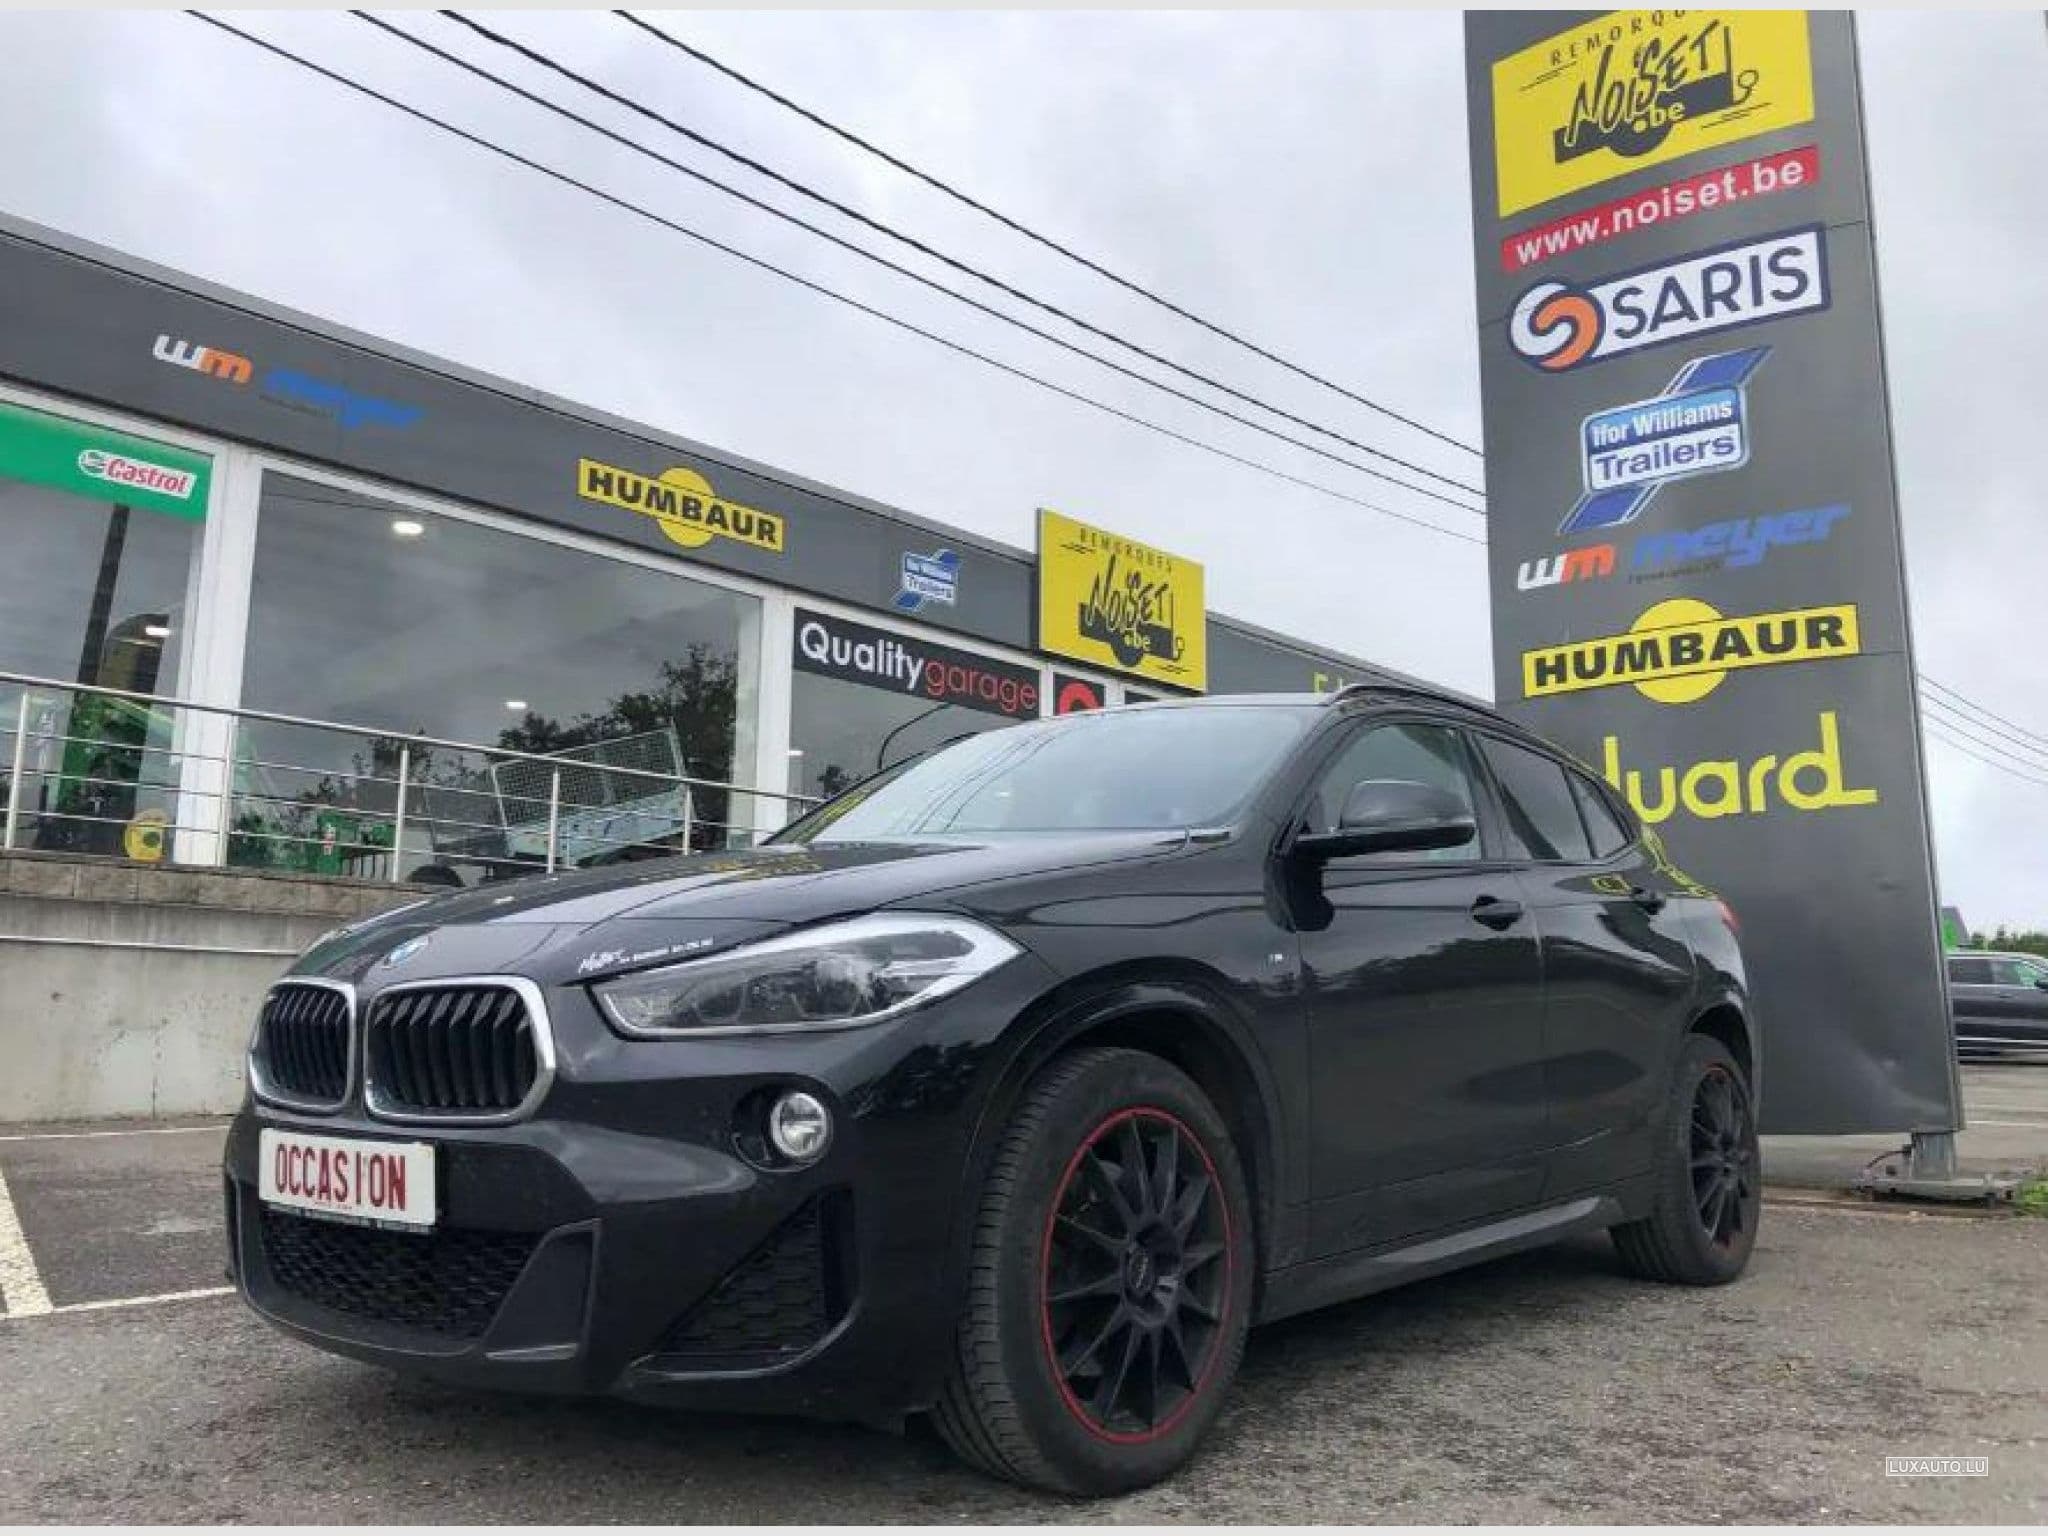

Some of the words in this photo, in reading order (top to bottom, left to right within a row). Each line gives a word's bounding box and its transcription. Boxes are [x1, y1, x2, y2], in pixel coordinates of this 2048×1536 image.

[1515, 160, 1804, 266] www.noiset.be
[1611, 247, 1809, 340] SARIS
[1632, 400, 1733, 437] Williams
[107, 458, 189, 493] Castrol
[1595, 435, 1735, 481] Trailers
[587, 467, 777, 545] HUMBAUR
[1632, 502, 1852, 569] meyer
[1535, 614, 1846, 688] HUMBAUR
[275, 1143, 406, 1212] OCCASION
